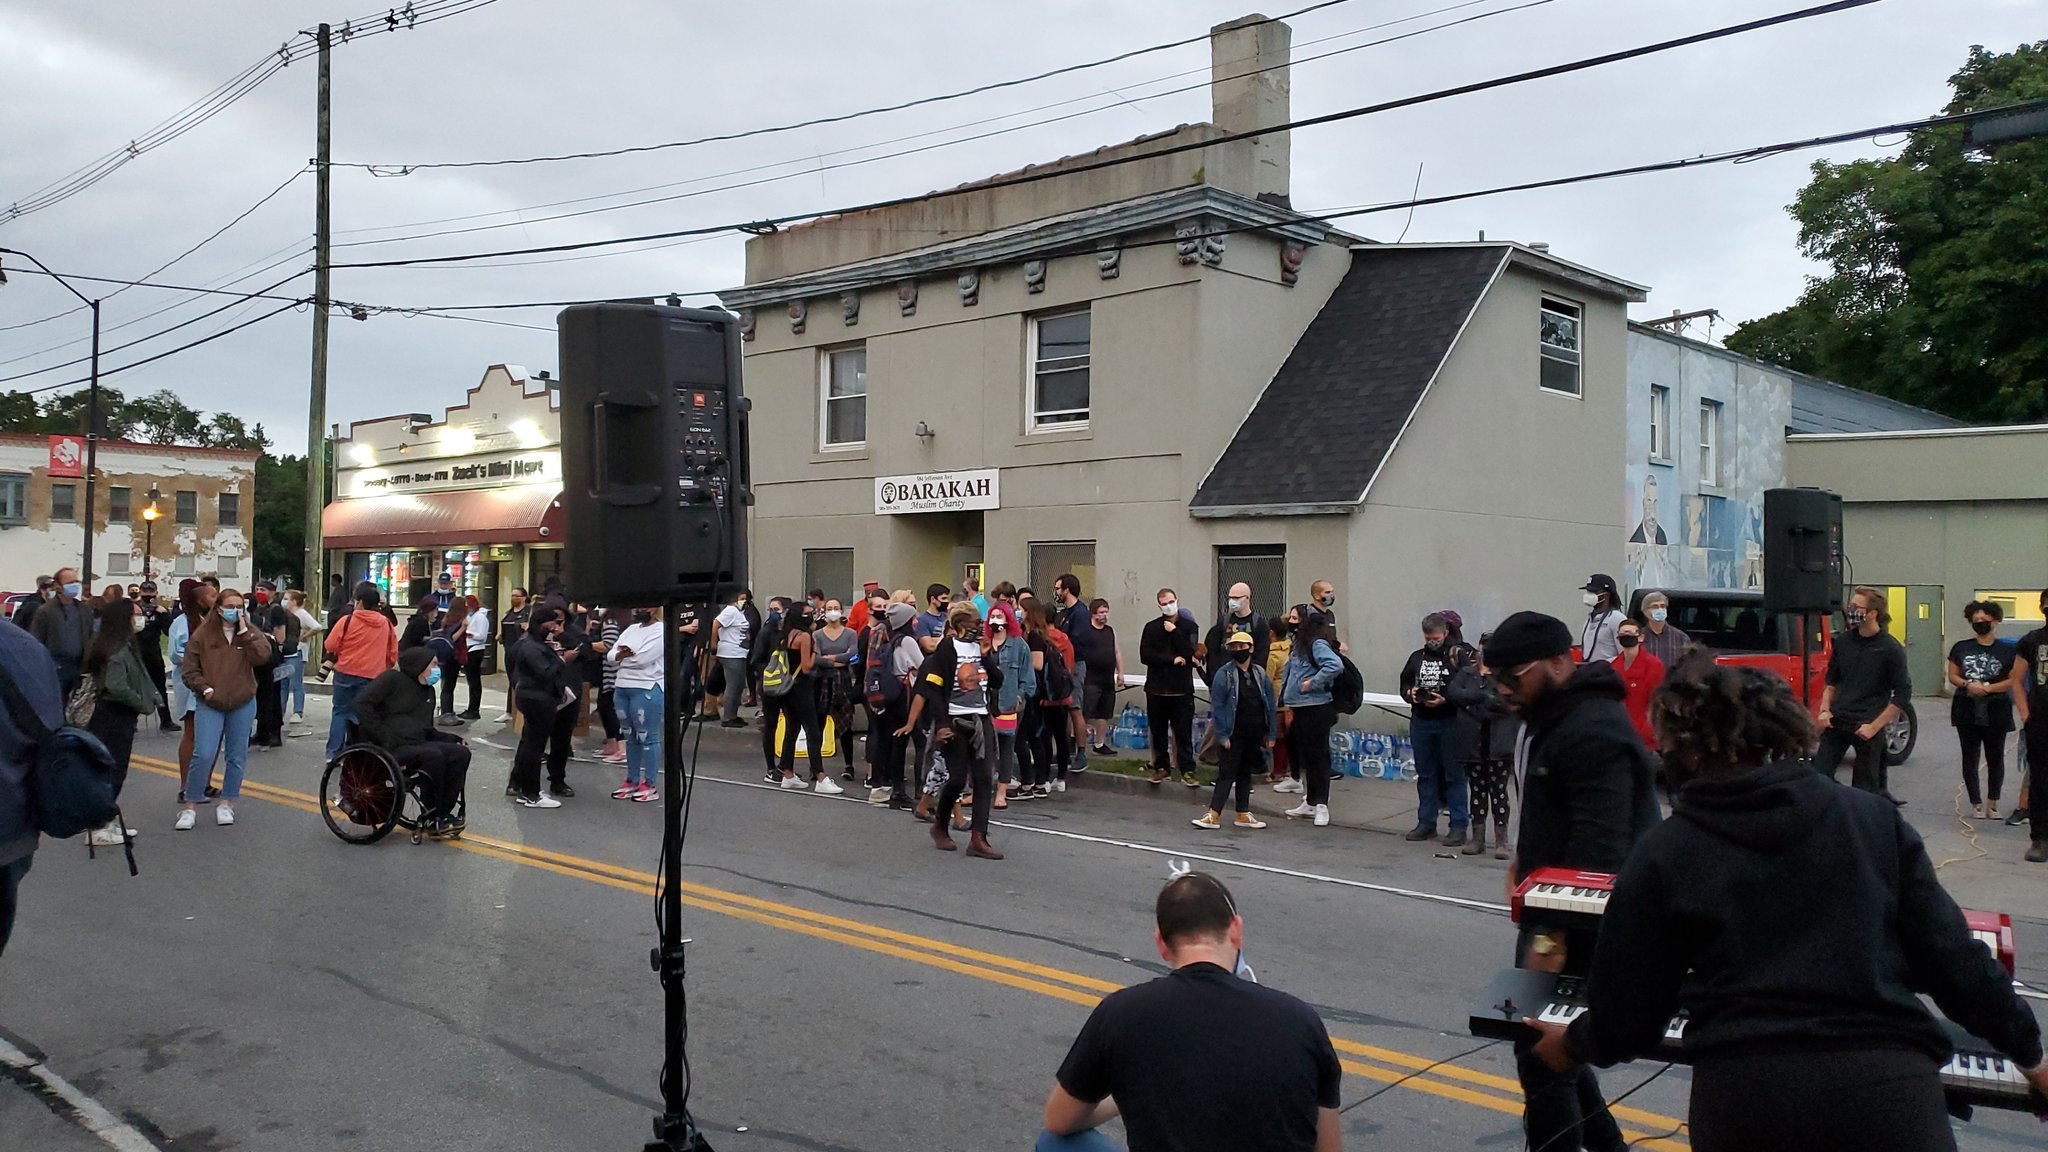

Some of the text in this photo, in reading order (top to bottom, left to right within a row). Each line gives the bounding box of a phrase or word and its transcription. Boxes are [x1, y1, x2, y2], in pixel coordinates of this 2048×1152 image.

[898, 479, 991, 501] BARAKAH
[910, 499, 937, 510] Muslim
[939, 498, 965, 509] Charity
